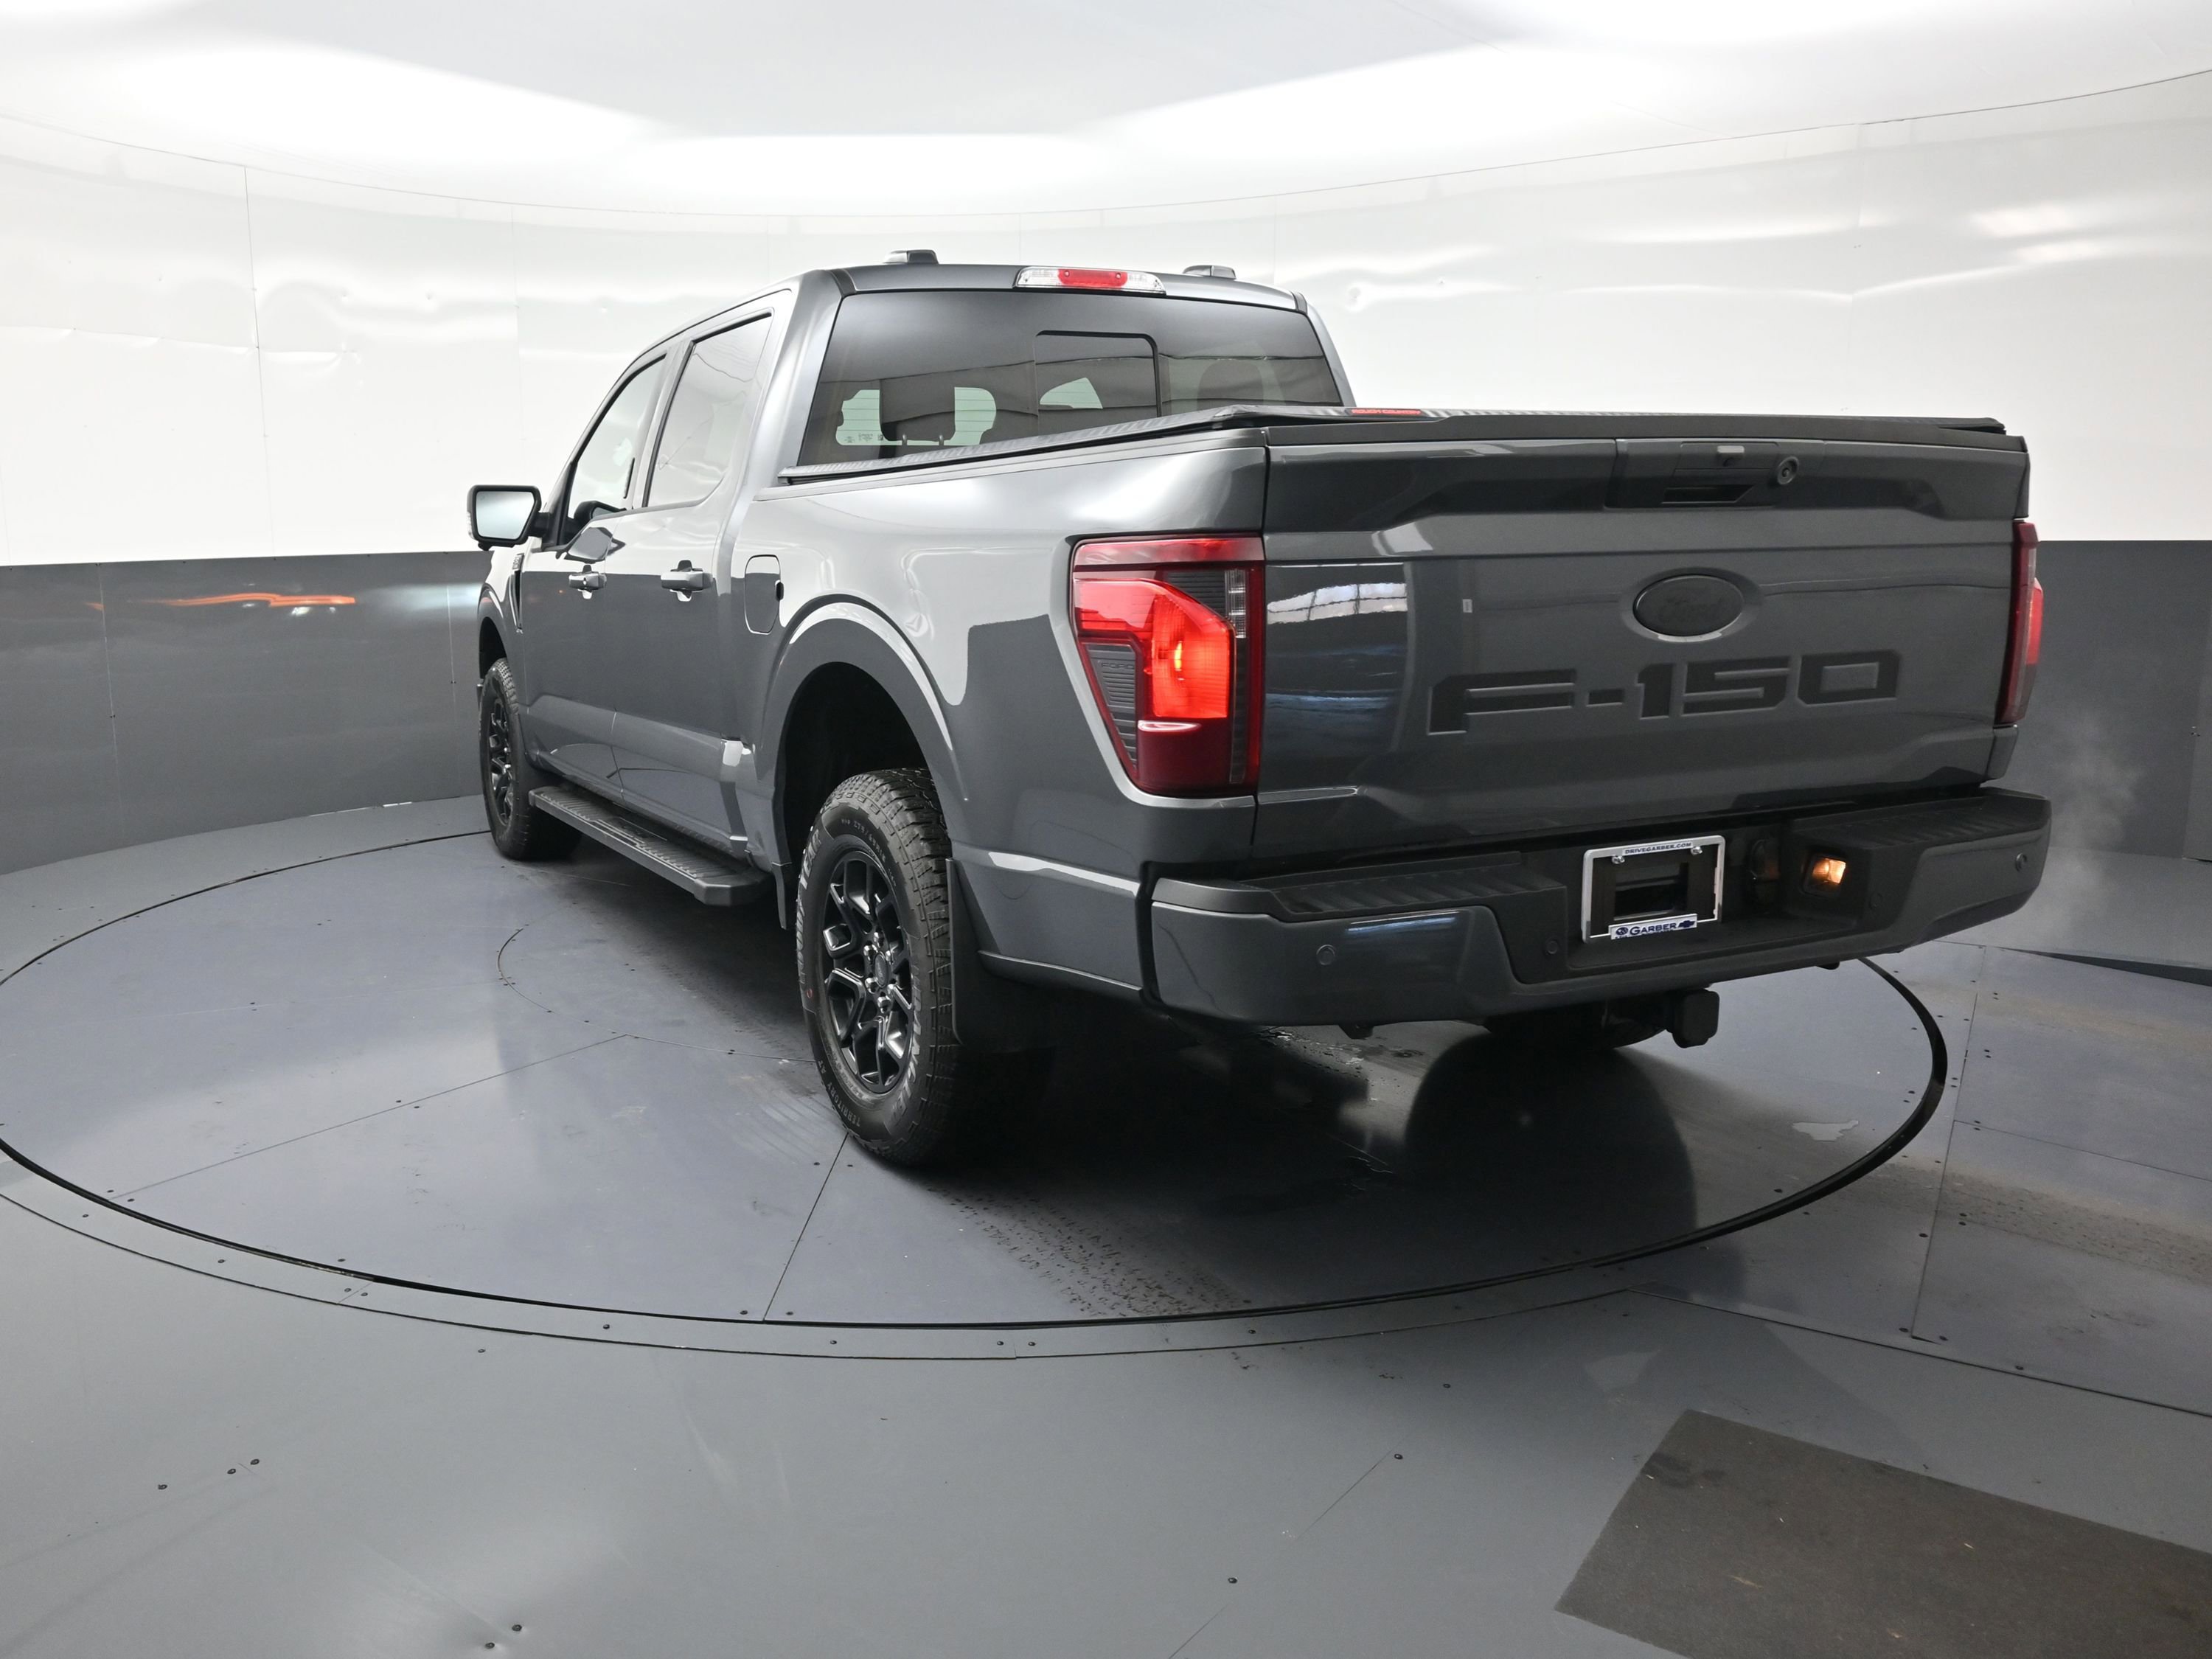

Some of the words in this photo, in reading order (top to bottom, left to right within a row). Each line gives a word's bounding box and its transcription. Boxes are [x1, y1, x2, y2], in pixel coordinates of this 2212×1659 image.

[1101, 662, 1135, 670] FORD
[1427, 649, 1902, 736] F-150
[1624, 842, 1692, 855] DRIVEGARBER.COM
[1630, 922, 1677, 936] GARBER
[817, 1060, 827, 1074] AT
[827, 1082, 860, 1127] TERRITORY
